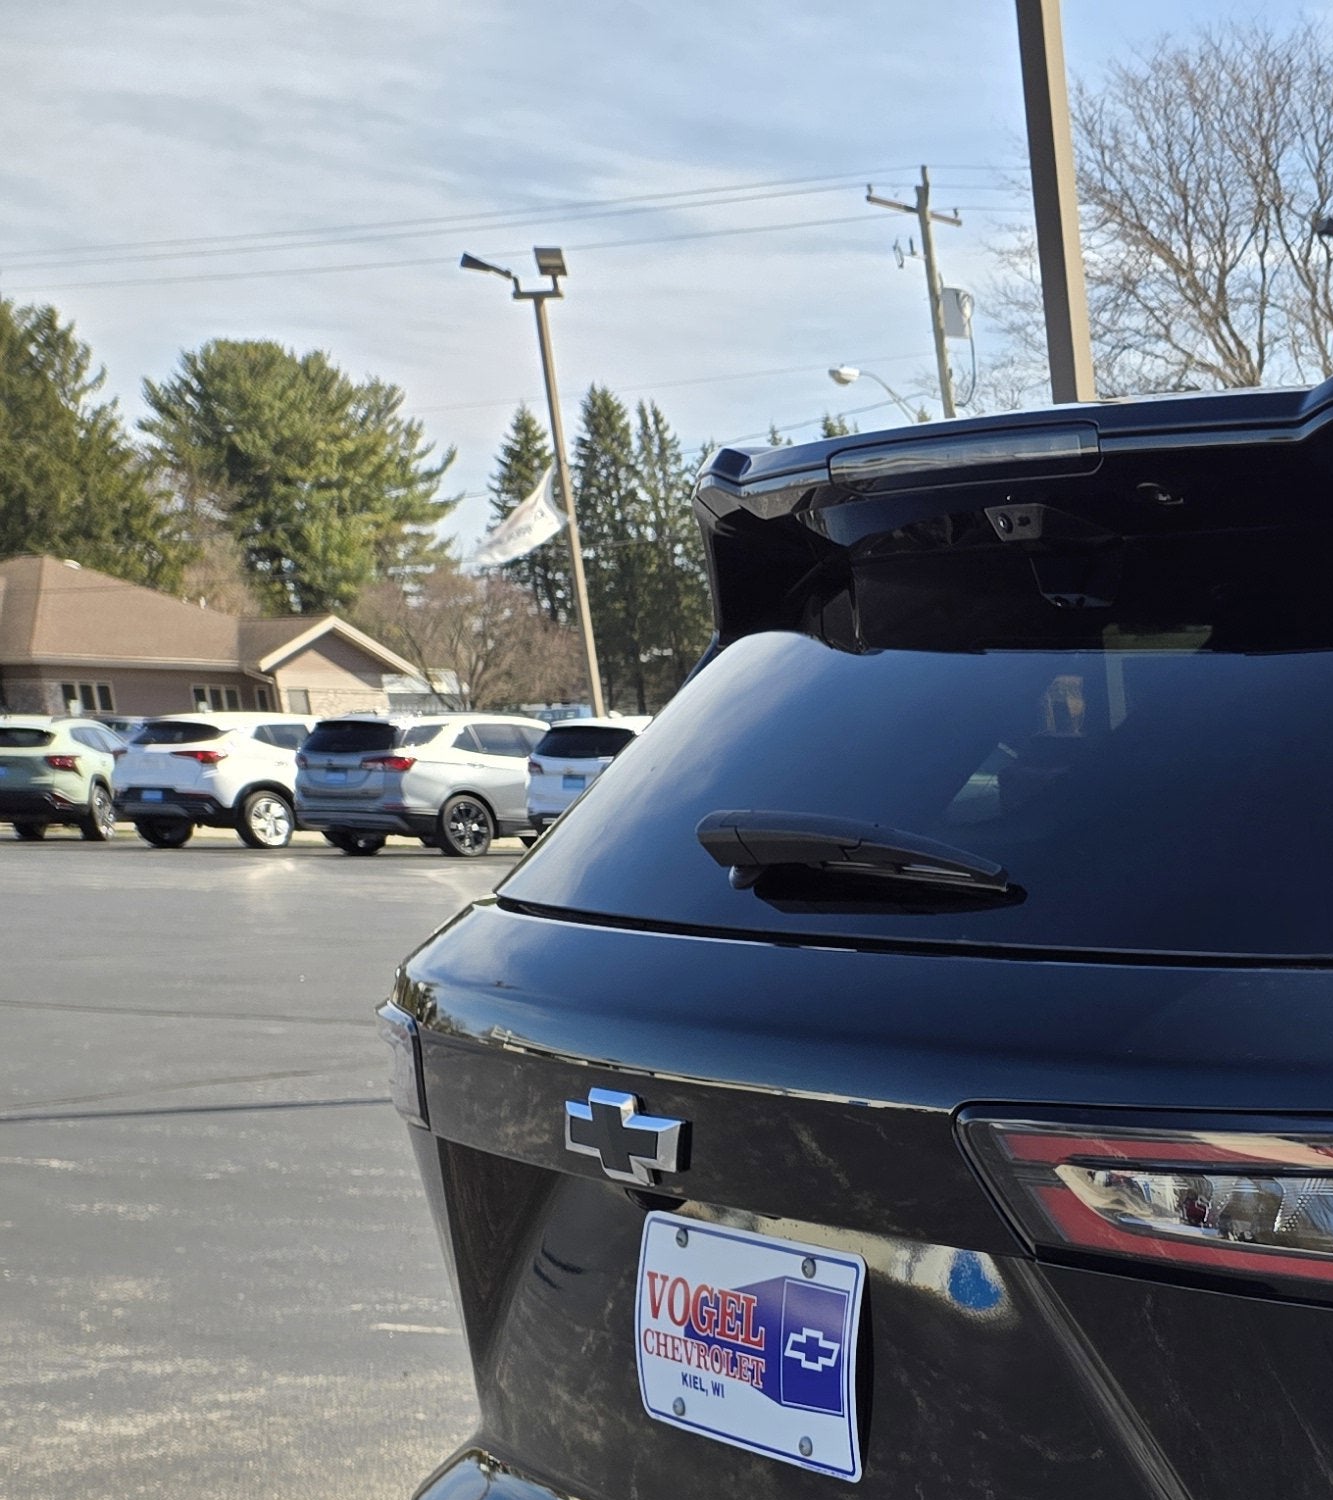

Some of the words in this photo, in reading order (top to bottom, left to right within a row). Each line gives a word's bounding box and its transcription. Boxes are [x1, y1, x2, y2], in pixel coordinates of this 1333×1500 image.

[646, 1270, 765, 1351] VOGEL
[643, 1328, 766, 1389] CHEVROLET
[681, 1371, 708, 1398] KIEL,
[711, 1382, 725, 1398] WI
